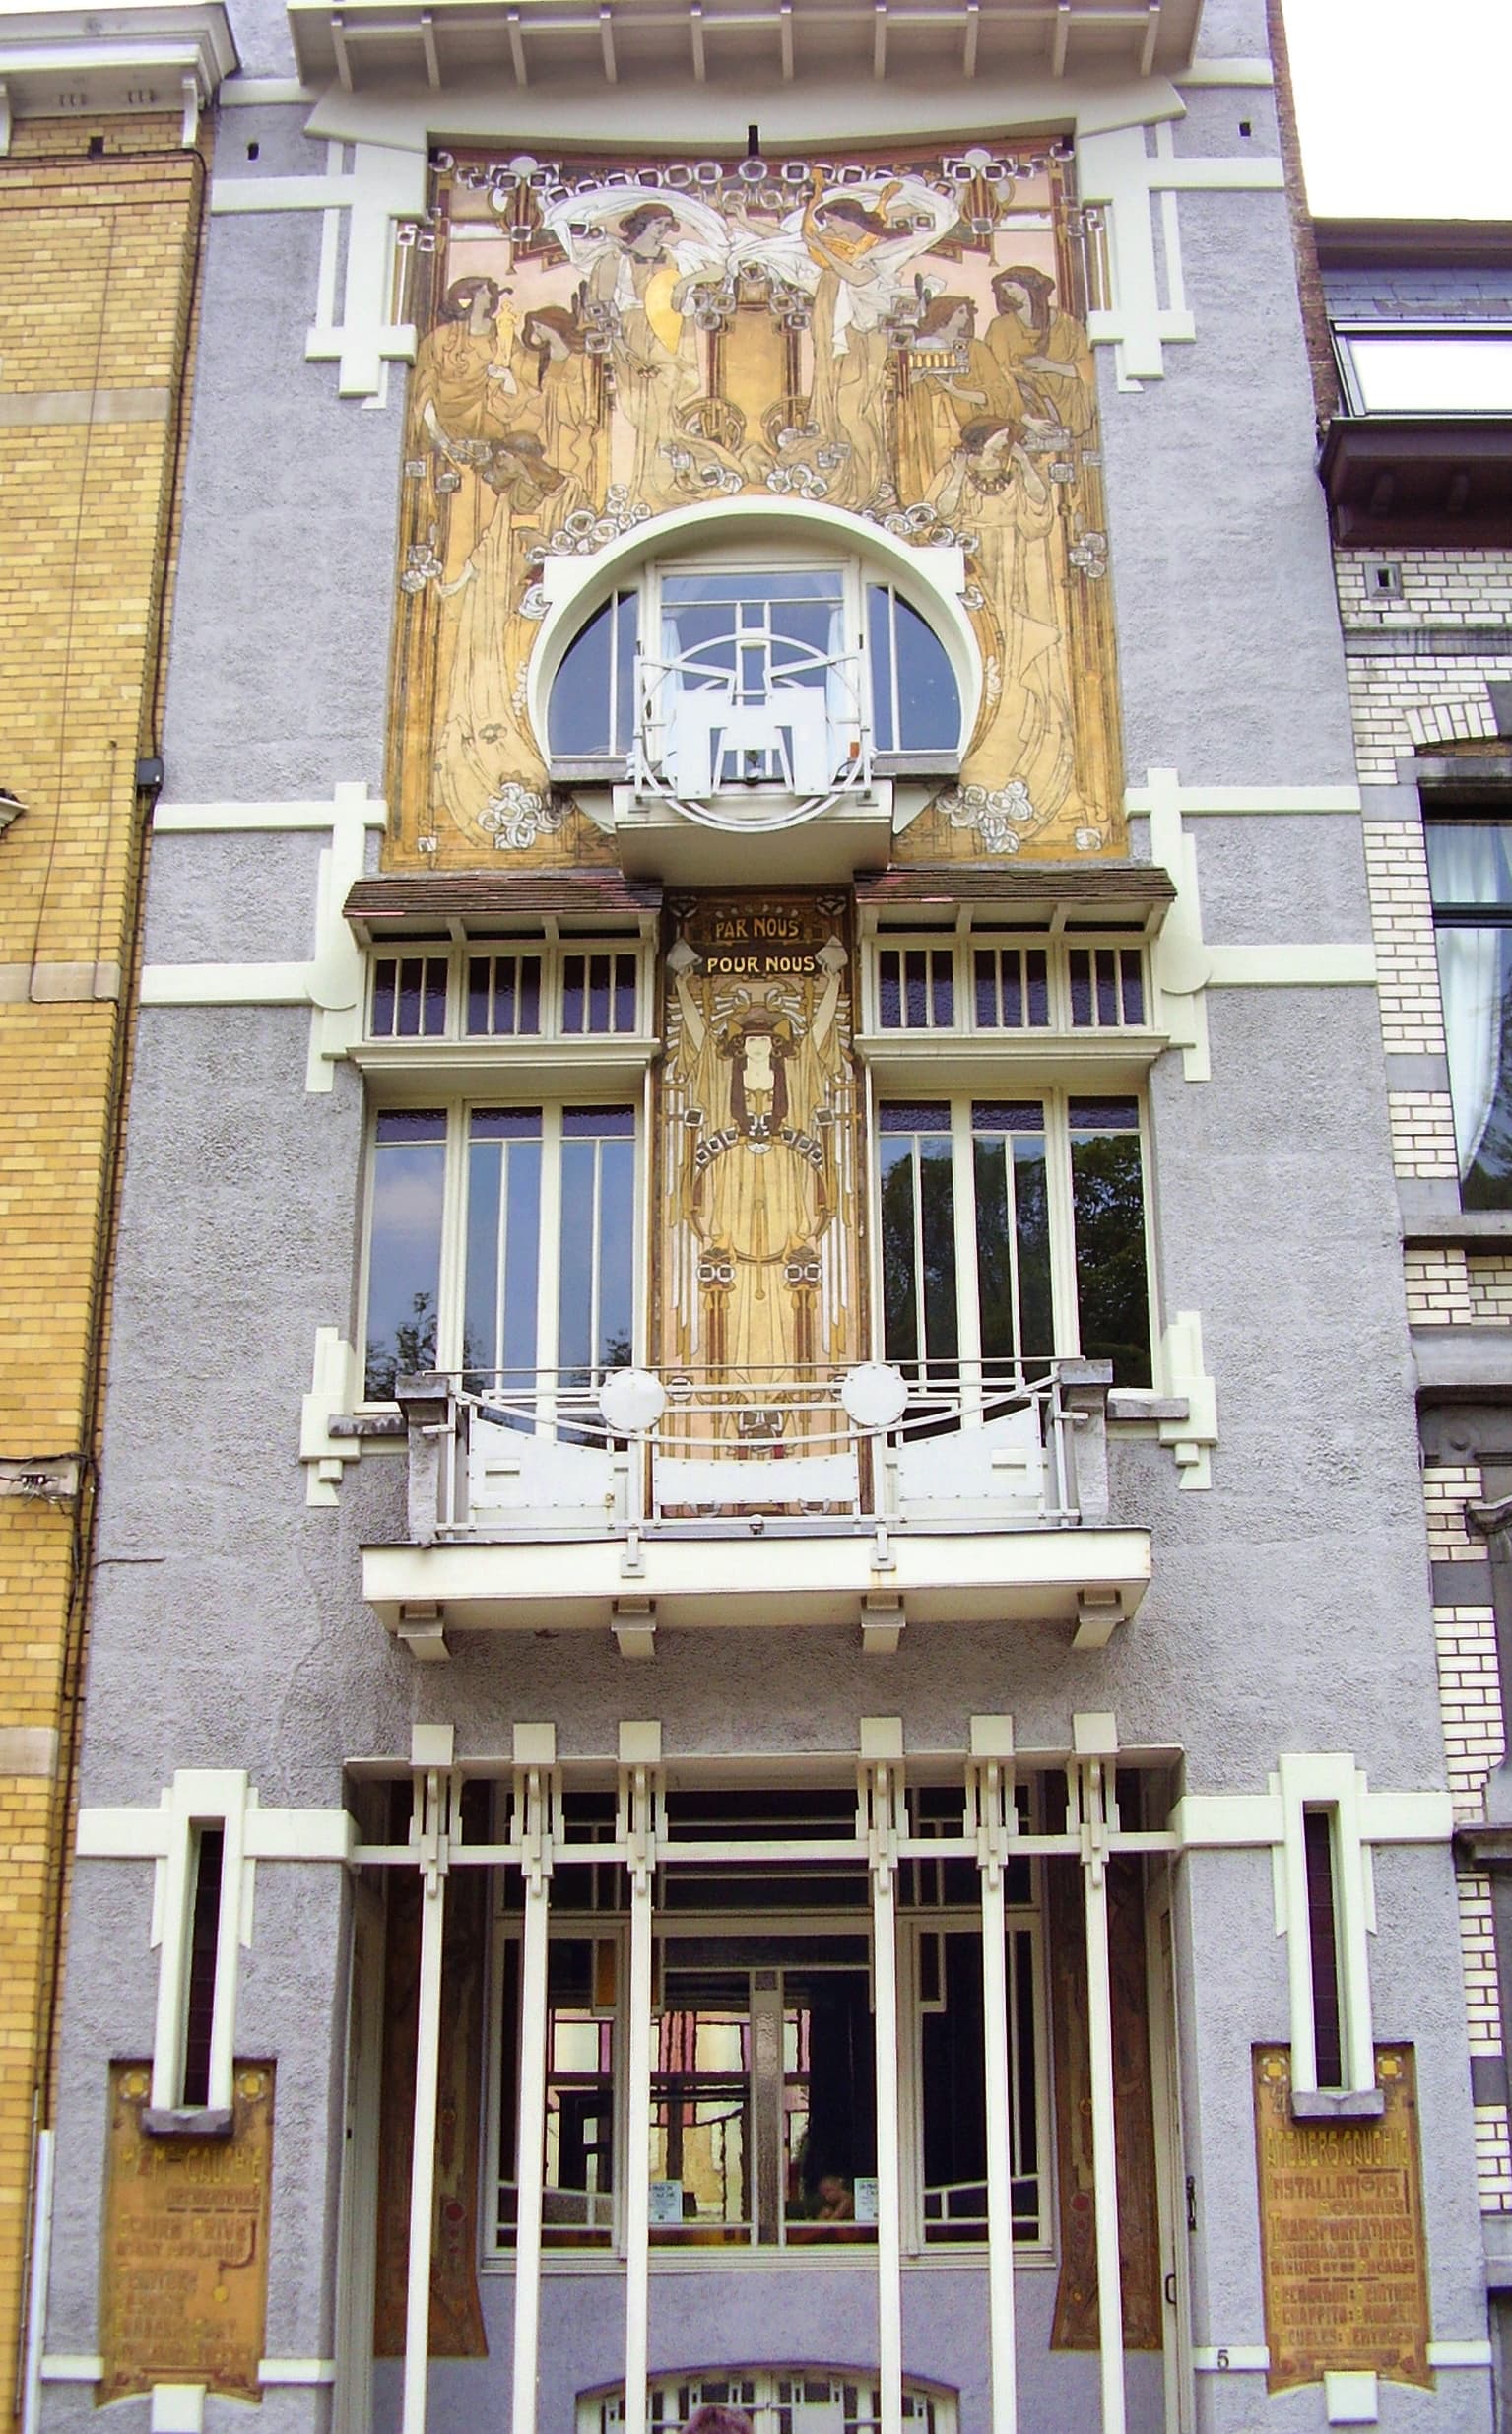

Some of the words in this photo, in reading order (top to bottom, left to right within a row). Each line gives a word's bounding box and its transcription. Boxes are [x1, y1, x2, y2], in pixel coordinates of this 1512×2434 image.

[716, 919, 748, 938] PAR
[753, 918, 800, 937] NOUS
[707, 957, 760, 973] POUR
[765, 956, 815, 972] NOUS
[1267, 2127, 1339, 2167] ATELIERS
[1343, 2127, 1410, 2167] CAUCHIE
[1268, 2174, 1399, 2199] INSTALLATIONS
[1269, 2211, 1413, 2241] TRANSFORMATIONS
[1217, 2349, 1230, 2372] 5
